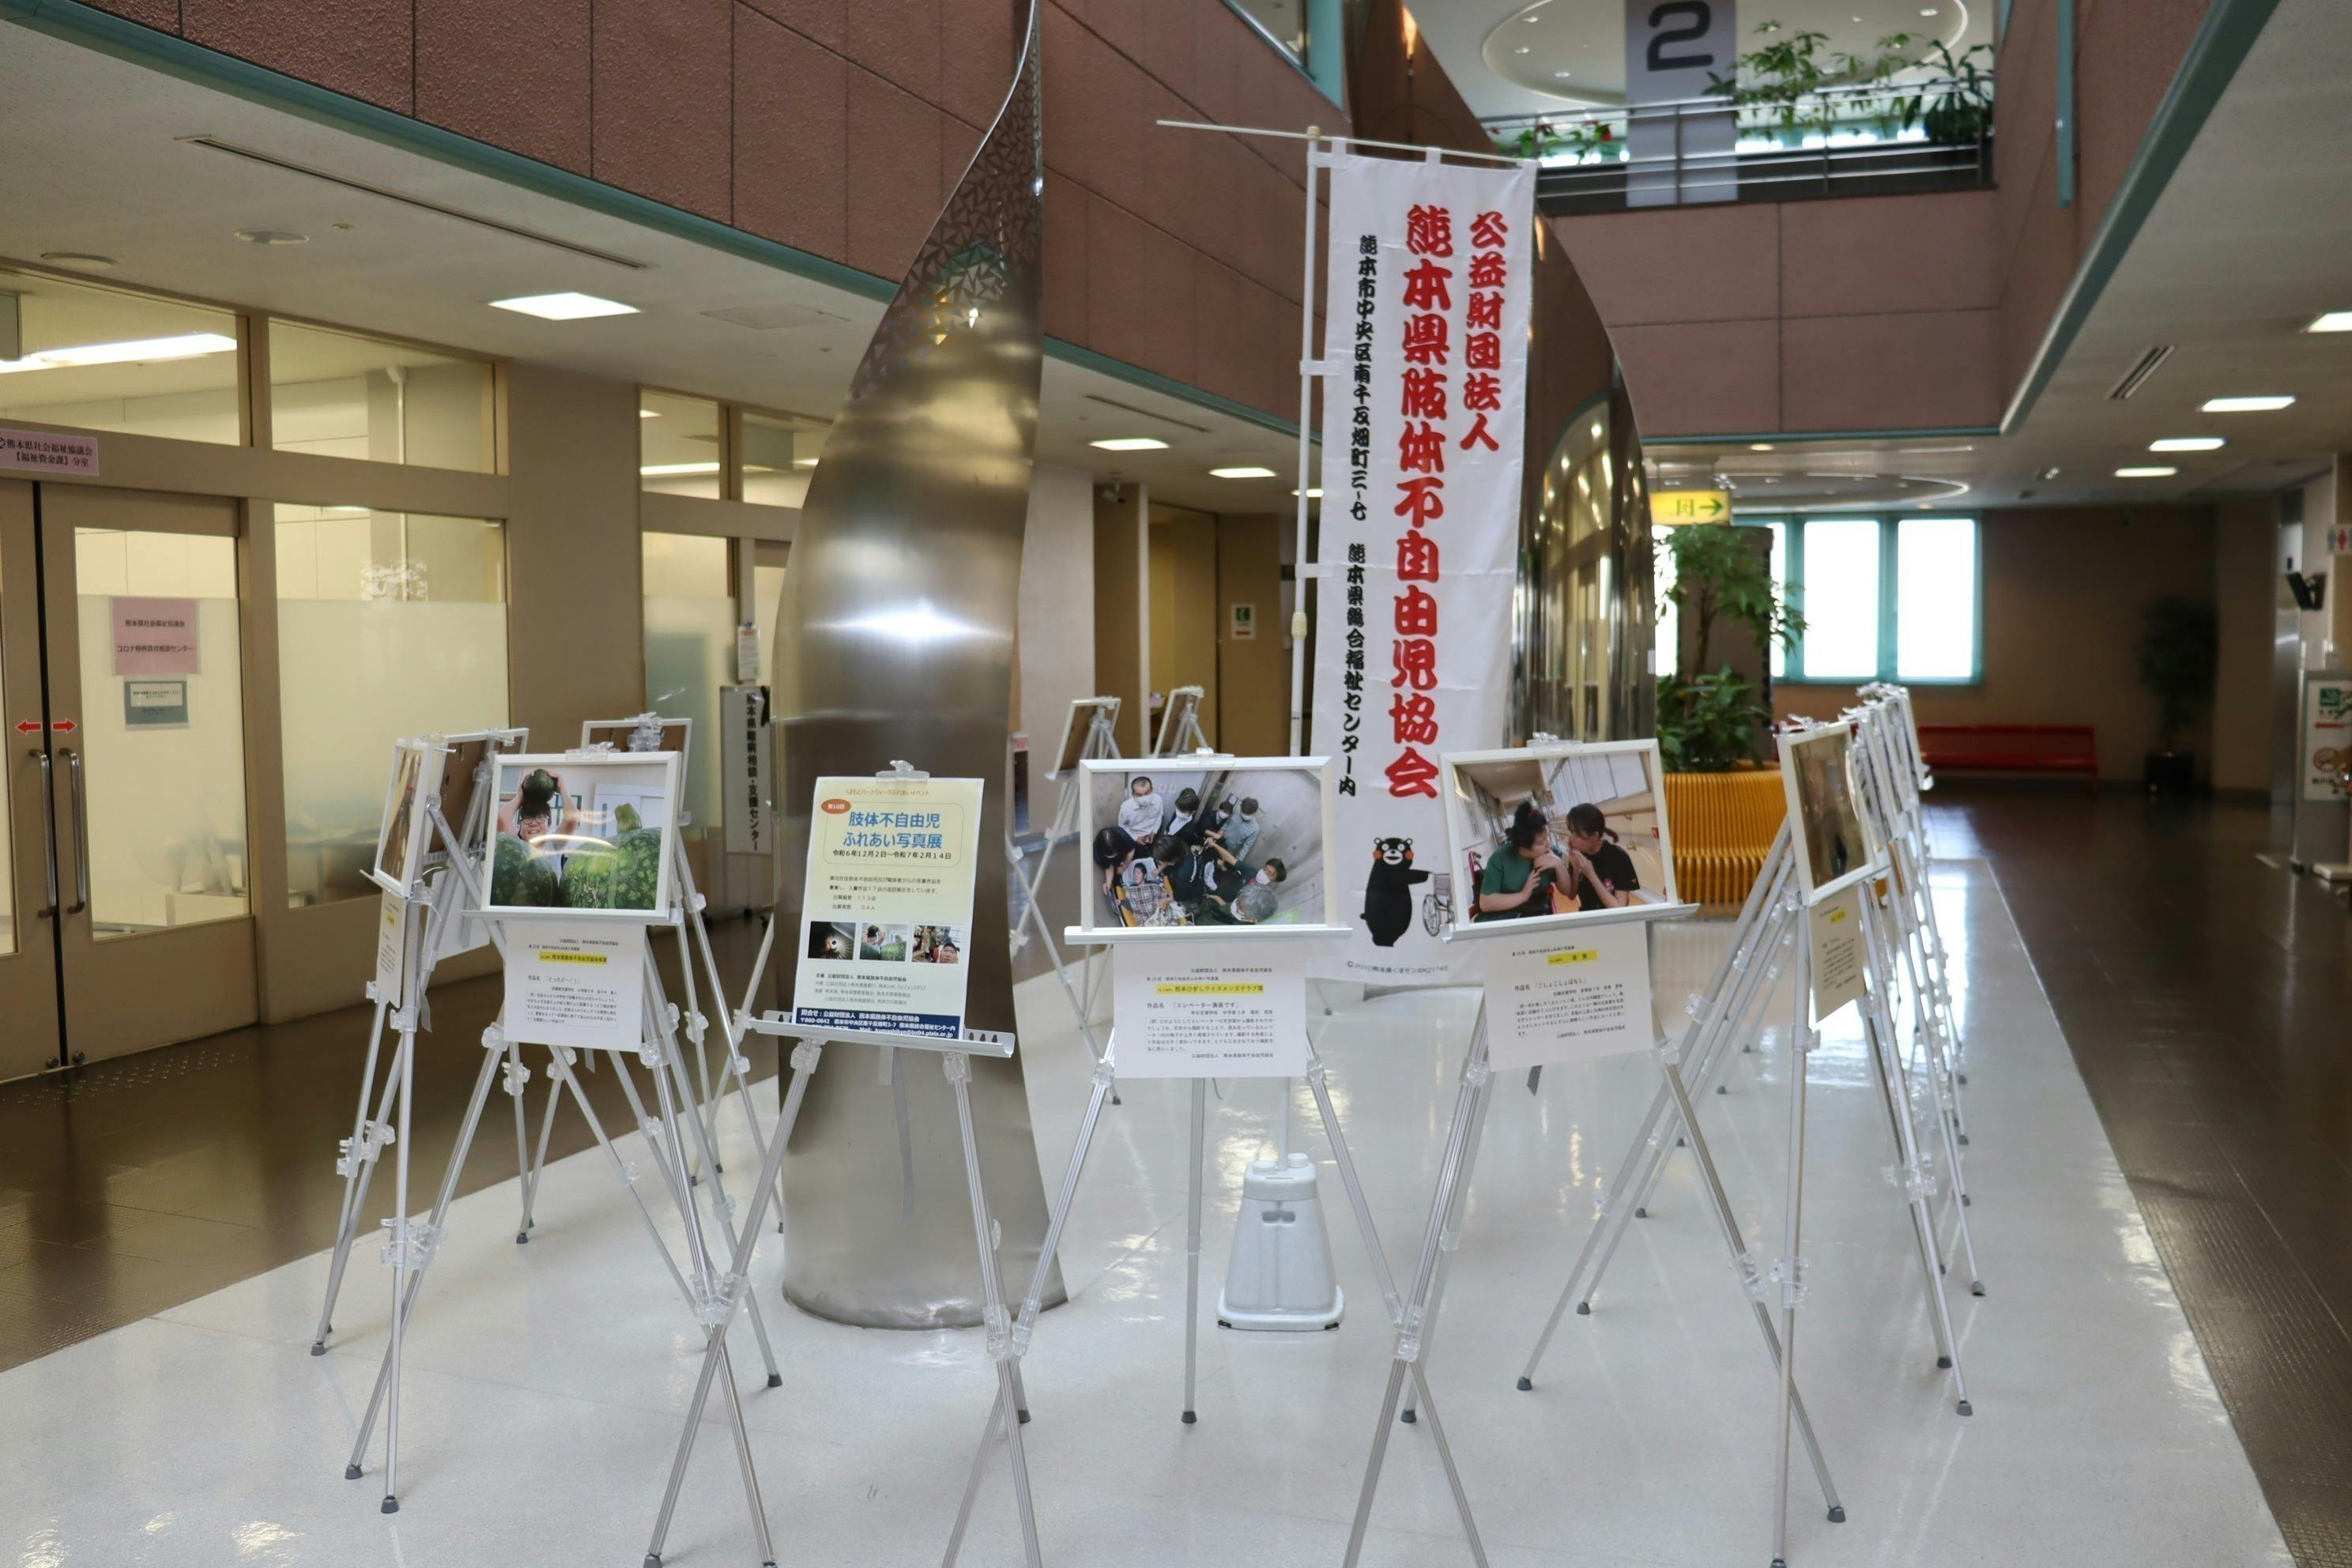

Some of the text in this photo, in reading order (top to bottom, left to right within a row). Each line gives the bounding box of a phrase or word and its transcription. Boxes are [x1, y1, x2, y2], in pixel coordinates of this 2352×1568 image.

[1647, 0, 1713, 71] 2
[1459, 211, 1509, 452] 公益財団法人
[6, 439, 92, 456] 熊本県社会福祉協議会
[1384, 203, 1454, 799] 熊本県肢体不自由児協会
[1338, 542, 1366, 797] 熊本県総合福祉センター内
[842, 831, 943, 850] ふれあい写真展
[848, 812, 940, 829] 肢体不自由児
[859, 1012, 920, 1022] 熊本県肢体不自由児協会
